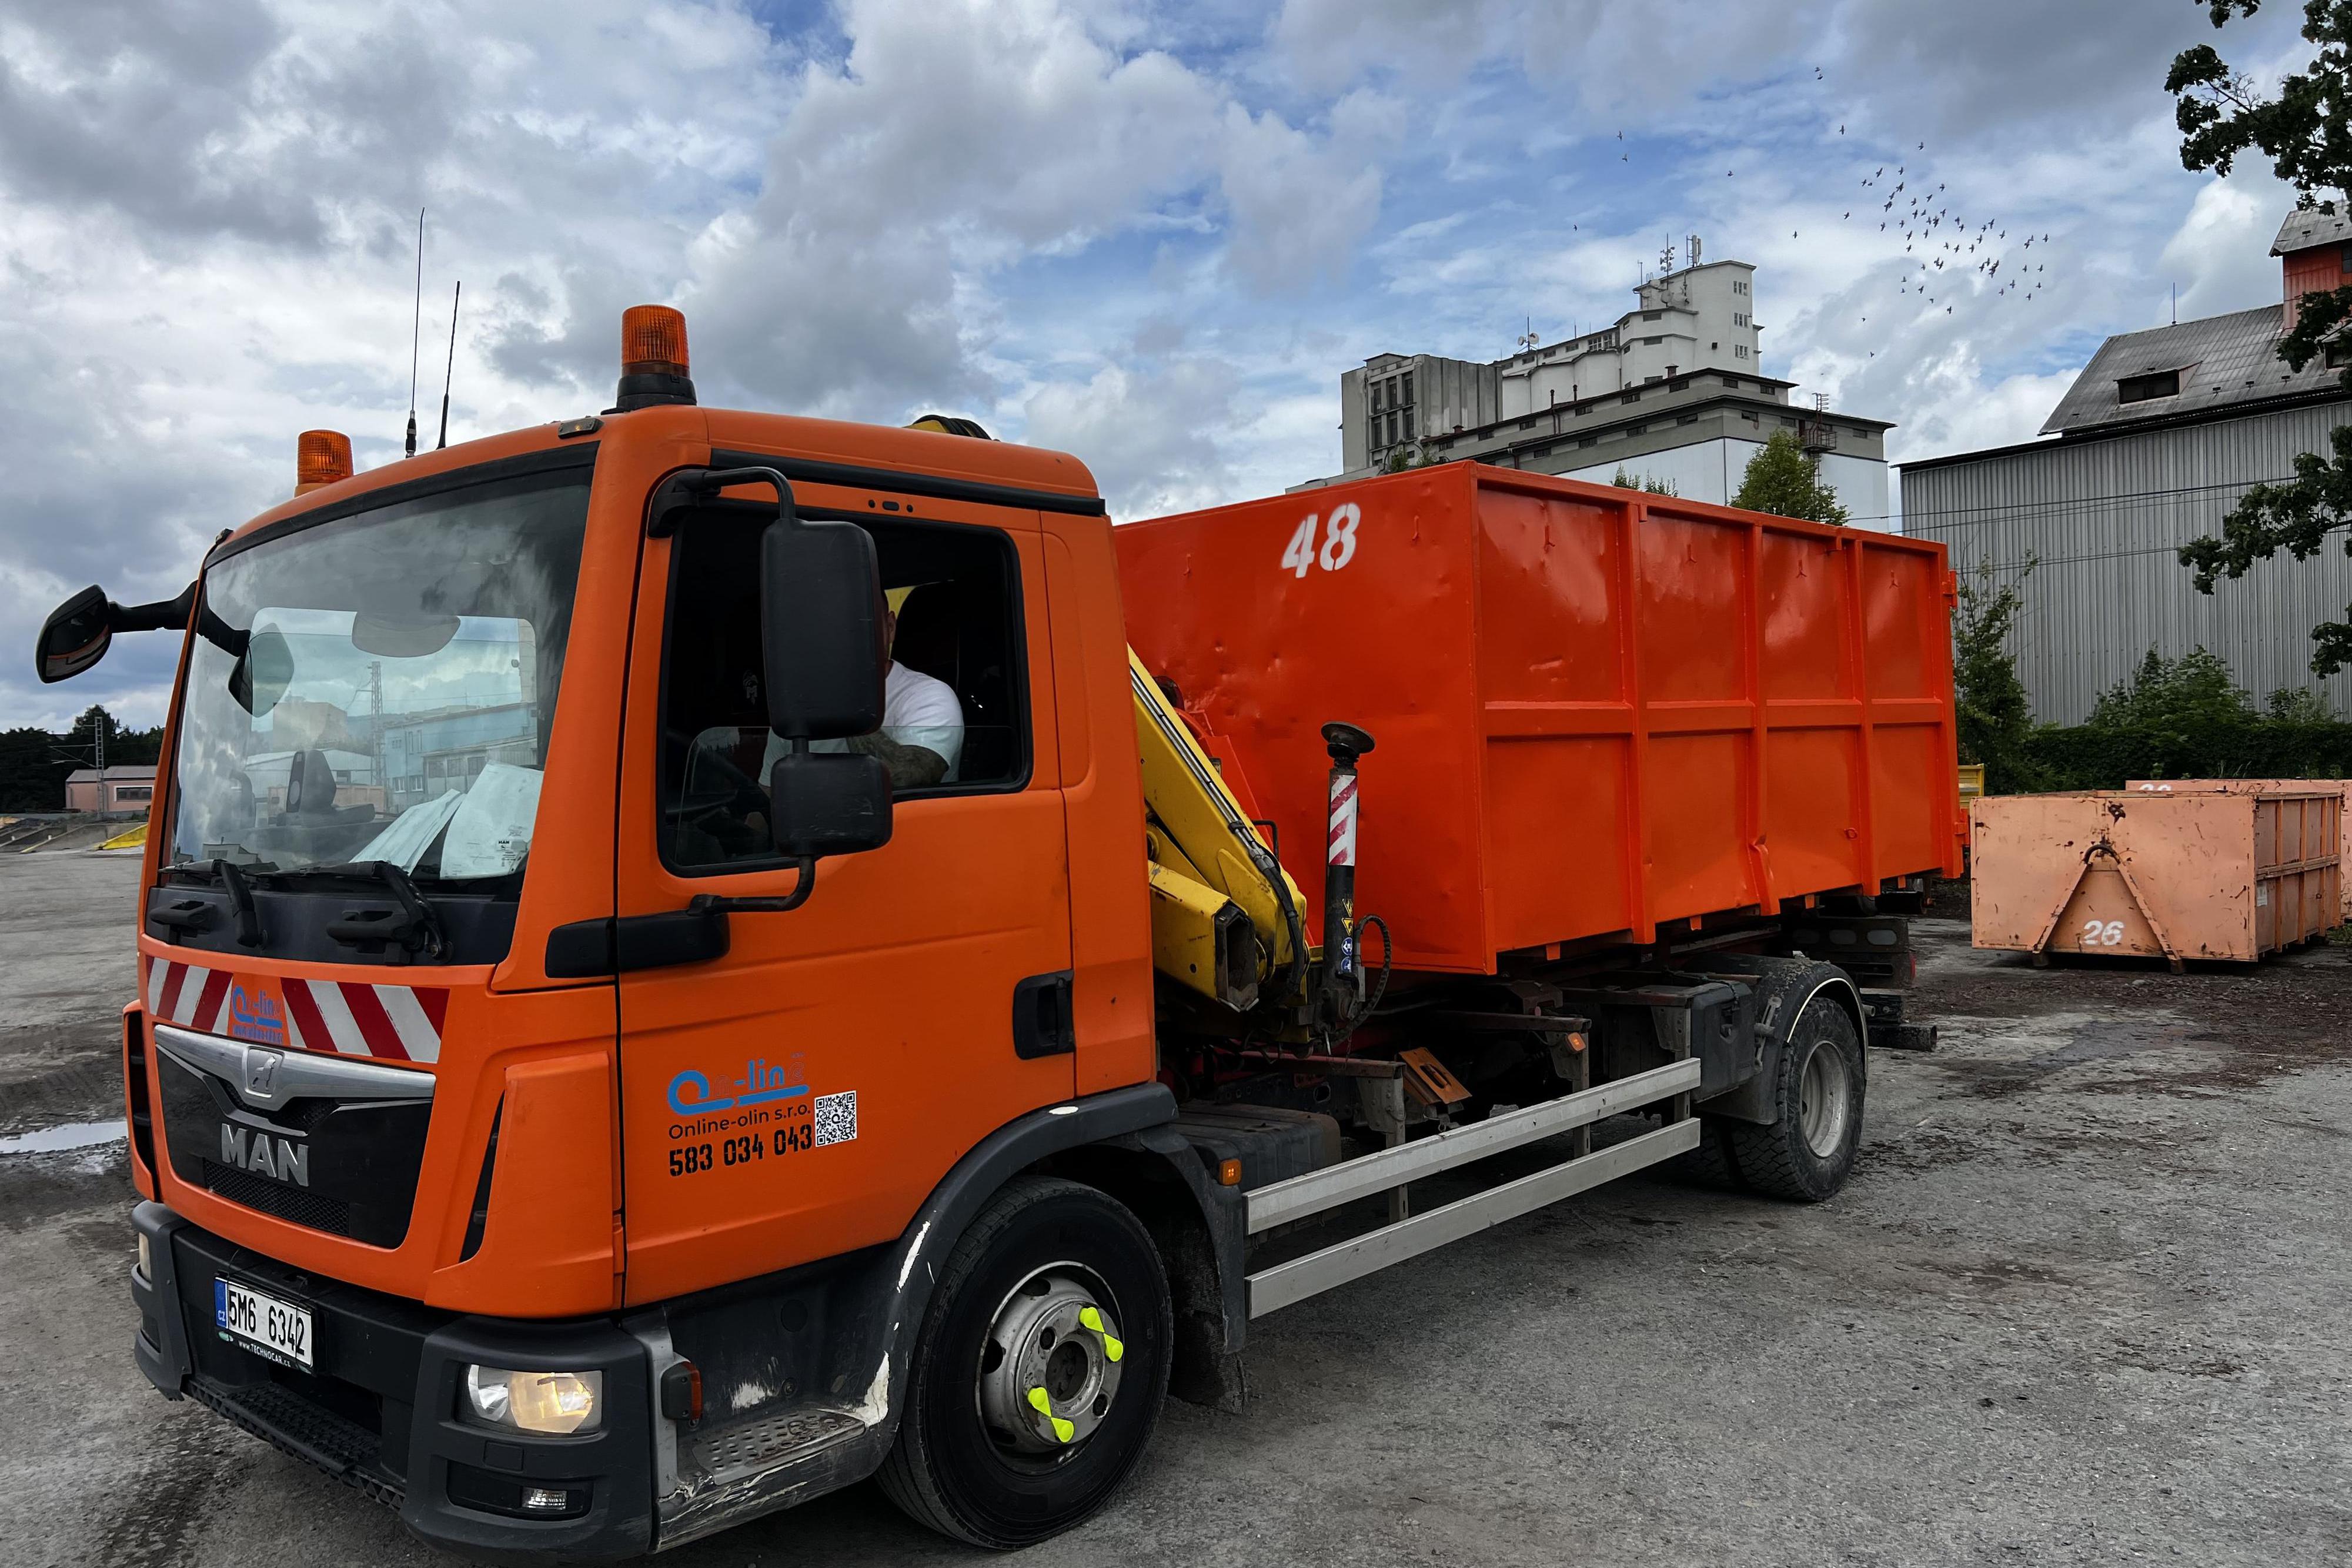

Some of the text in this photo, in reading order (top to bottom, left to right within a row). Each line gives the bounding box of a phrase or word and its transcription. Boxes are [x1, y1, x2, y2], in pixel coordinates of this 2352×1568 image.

[1281, 502, 1361, 579] 48
[2083, 920, 2125, 946] 26
[669, 1104, 811, 1139] Online-olin s.r.o.
[221, 1122, 310, 1187] MAN
[669, 1124, 813, 1177] 583 034 043
[218, 1310, 226, 1322] CZ
[229, 1290, 305, 1356] 5M6 6342
